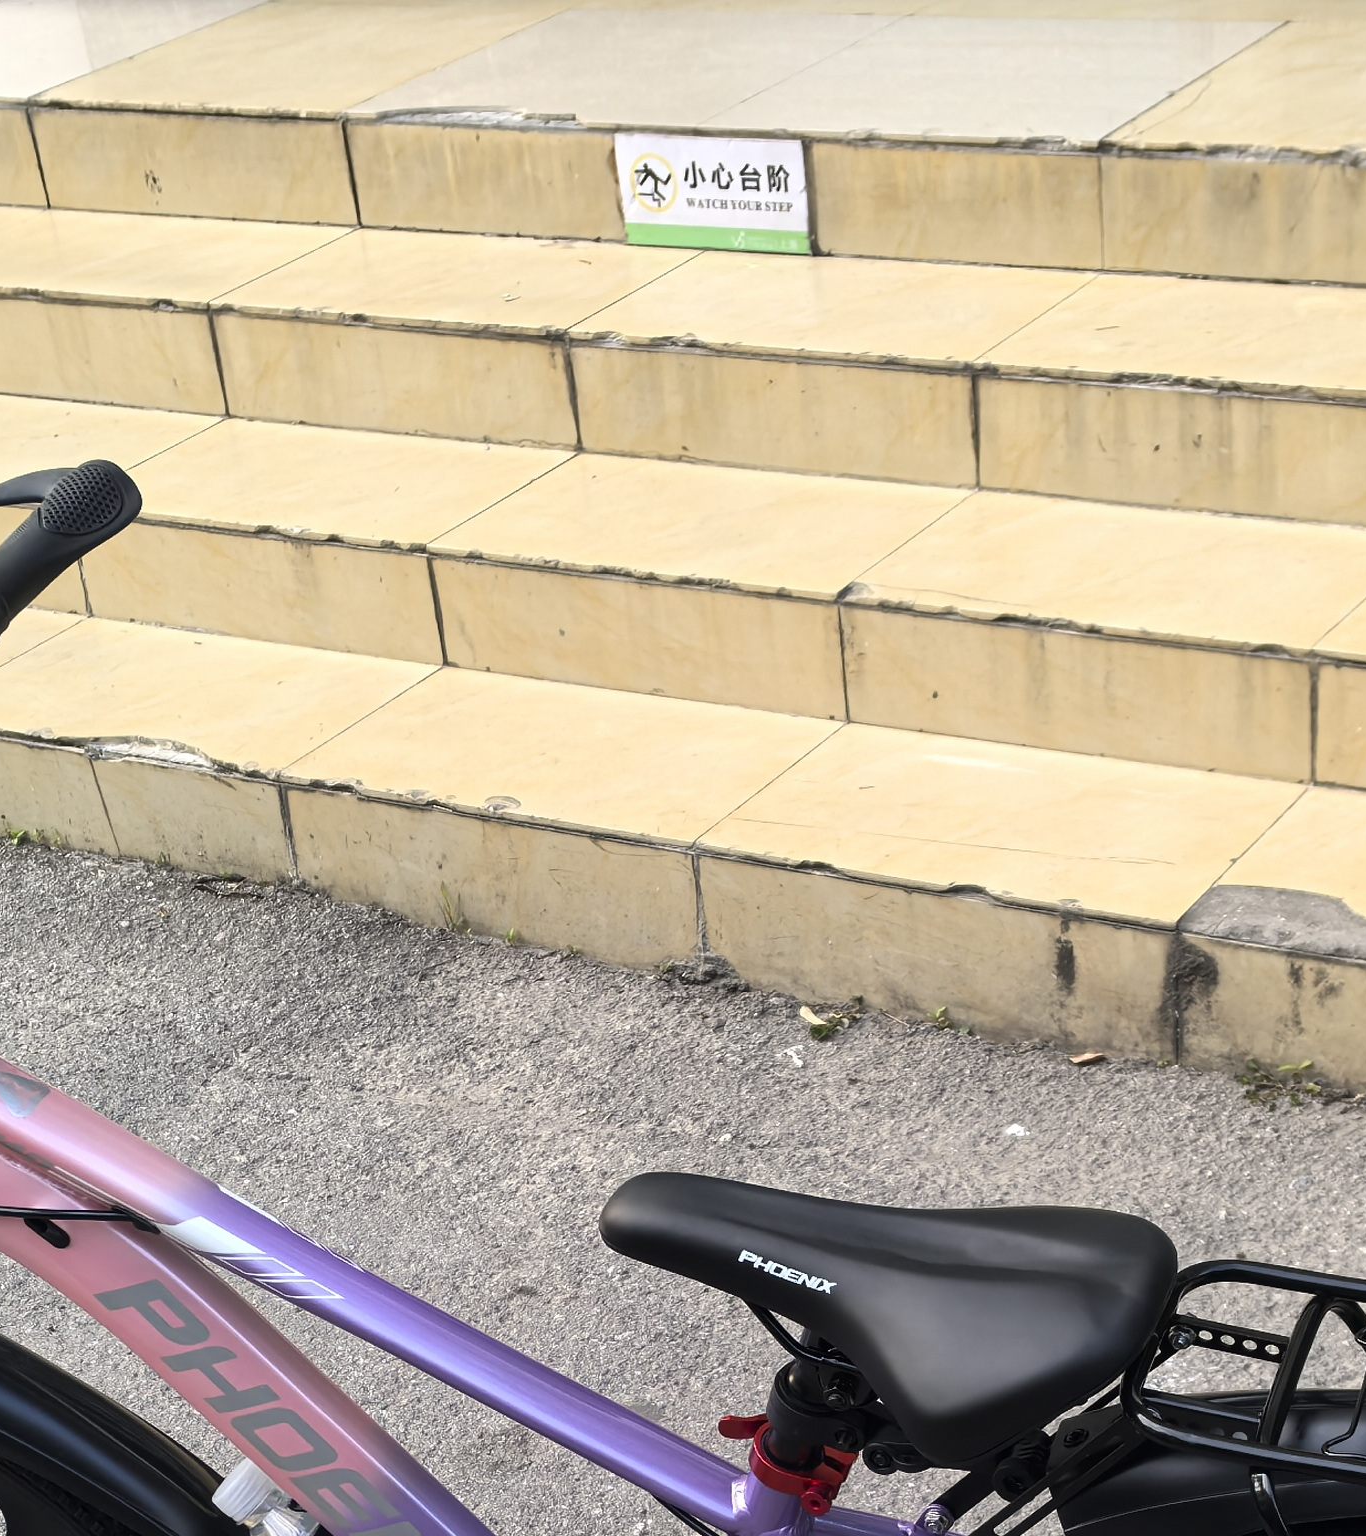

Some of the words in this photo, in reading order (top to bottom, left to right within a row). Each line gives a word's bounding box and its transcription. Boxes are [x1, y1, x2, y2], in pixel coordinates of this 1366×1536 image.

[683, 160, 790, 194] 小心台阶
[686, 197, 728, 210] WATCH
[730, 199, 763, 211] YOUR
[764, 201, 794, 213] STEP
[737, 1249, 837, 1295] PHOENIX
